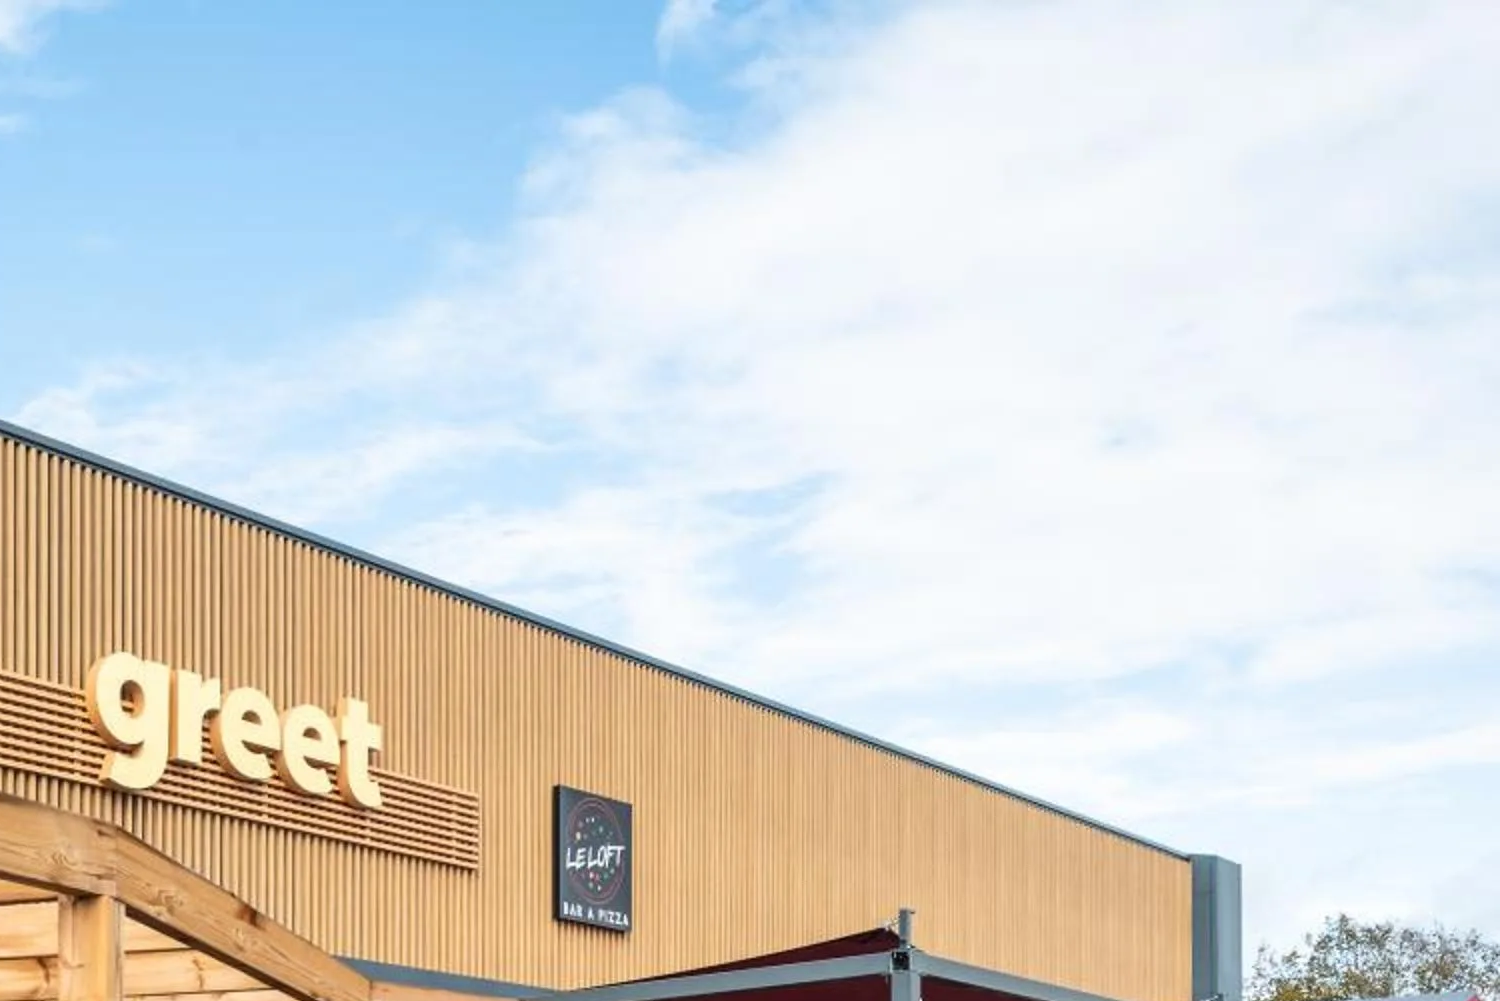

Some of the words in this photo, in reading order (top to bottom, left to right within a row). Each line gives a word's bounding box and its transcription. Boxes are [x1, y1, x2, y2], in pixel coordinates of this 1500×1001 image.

[87, 652, 382, 809] greet
[563, 901, 583, 917] BAR
[598, 909, 629, 926] PIZZA
